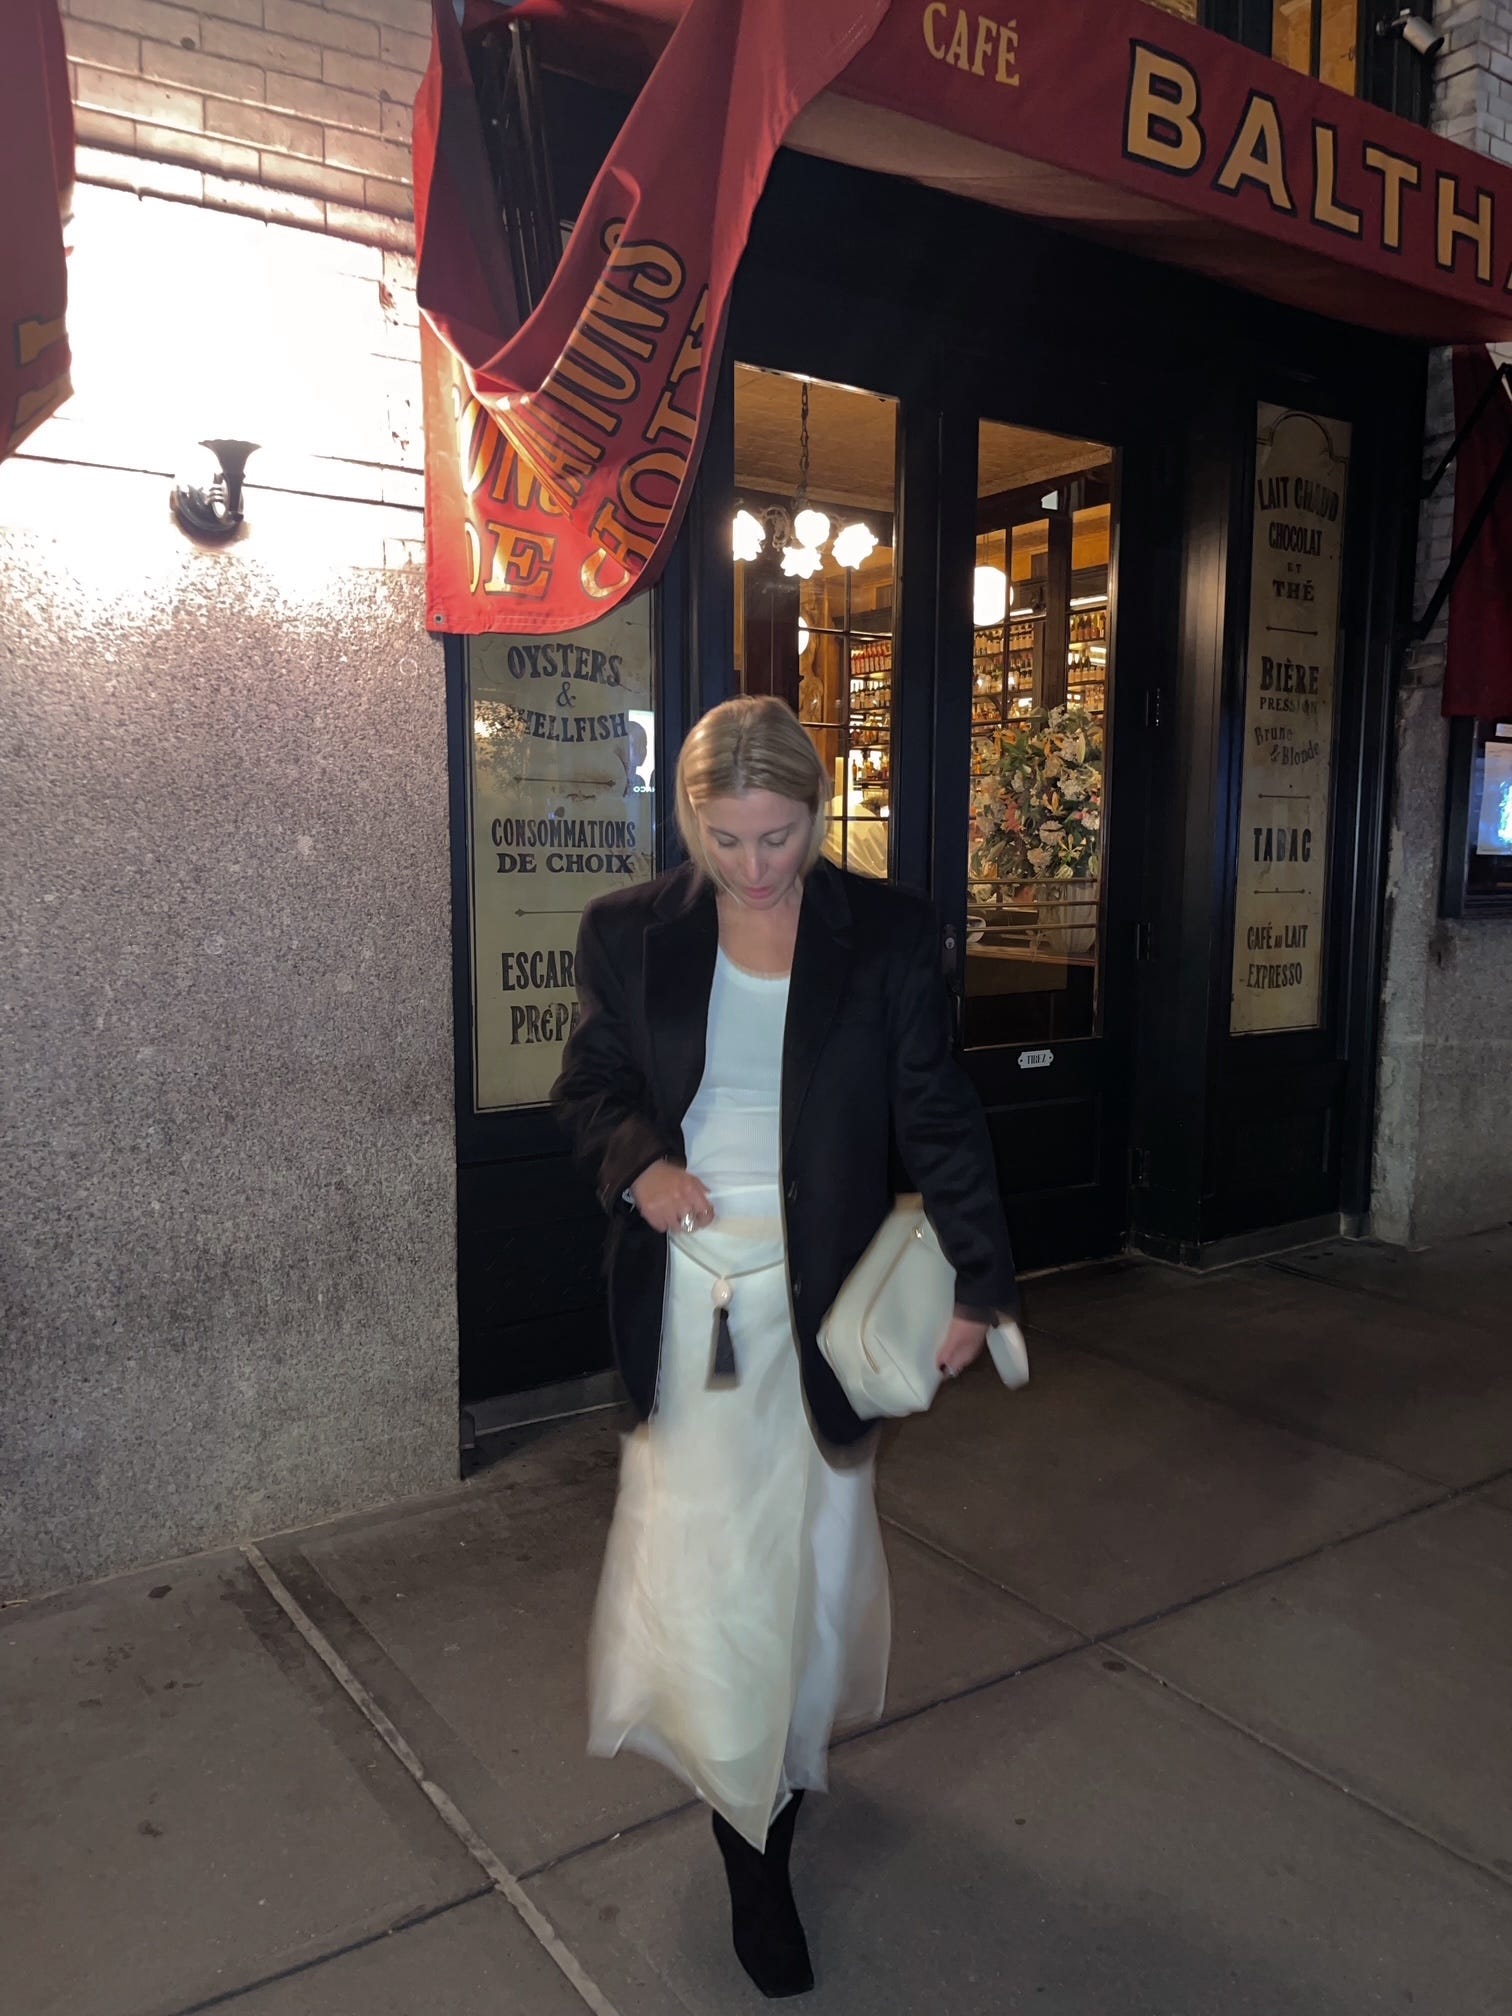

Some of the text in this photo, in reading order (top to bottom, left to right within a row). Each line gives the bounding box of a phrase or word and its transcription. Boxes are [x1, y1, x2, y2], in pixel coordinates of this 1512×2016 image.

[922, 2, 1020, 87] CAFÉ
[1122, 38, 1512, 294] BALTH
[1258, 477, 1289, 511] LAIT
[1269, 521, 1323, 557] CHOCOLAT
[1287, 562, 1302, 574] ET
[1272, 579, 1315, 601] THÉ
[507, 643, 623, 687] OYSTERS
[1260, 656, 1320, 694] BIÈRE
[557, 682, 576, 707] &
[515, 711, 629, 743] HELLFISH
[491, 818, 636, 848] CONSOMMATIONS
[1253, 827, 1312, 862] TABAC
[496, 852, 635, 874] DE CHOIX
[1247, 922, 1273, 951] CAFÉ
[1284, 925, 1308, 949] LAIT
[501, 950, 577, 991] ESCAR
[1246, 962, 1303, 989] EXPRESSO
